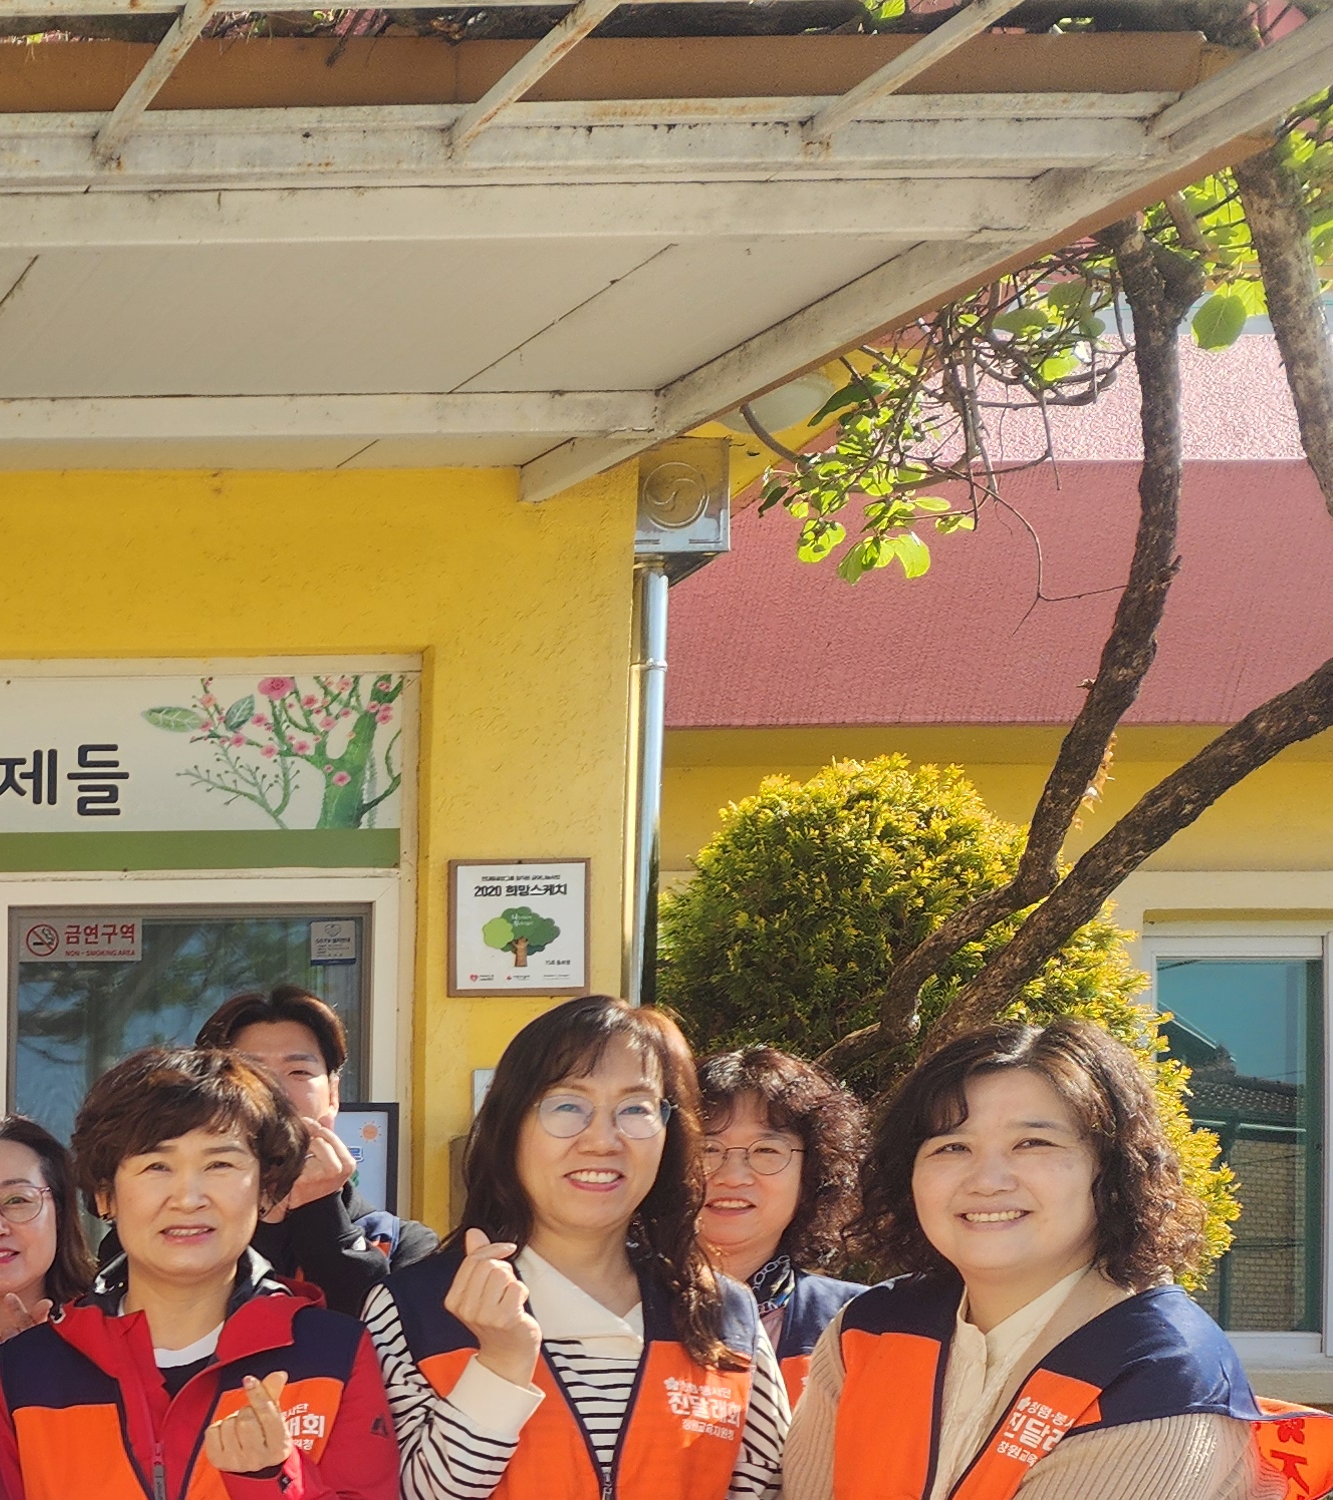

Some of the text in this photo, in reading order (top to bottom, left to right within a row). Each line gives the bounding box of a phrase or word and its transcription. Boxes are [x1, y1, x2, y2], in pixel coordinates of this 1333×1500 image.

[474, 883, 568, 897] 2020 희망스케치
[65, 923, 136, 945] 금연구역
[666, 1391, 741, 1428] 진달래회
[996, 1441, 1039, 1467] 창원교육
